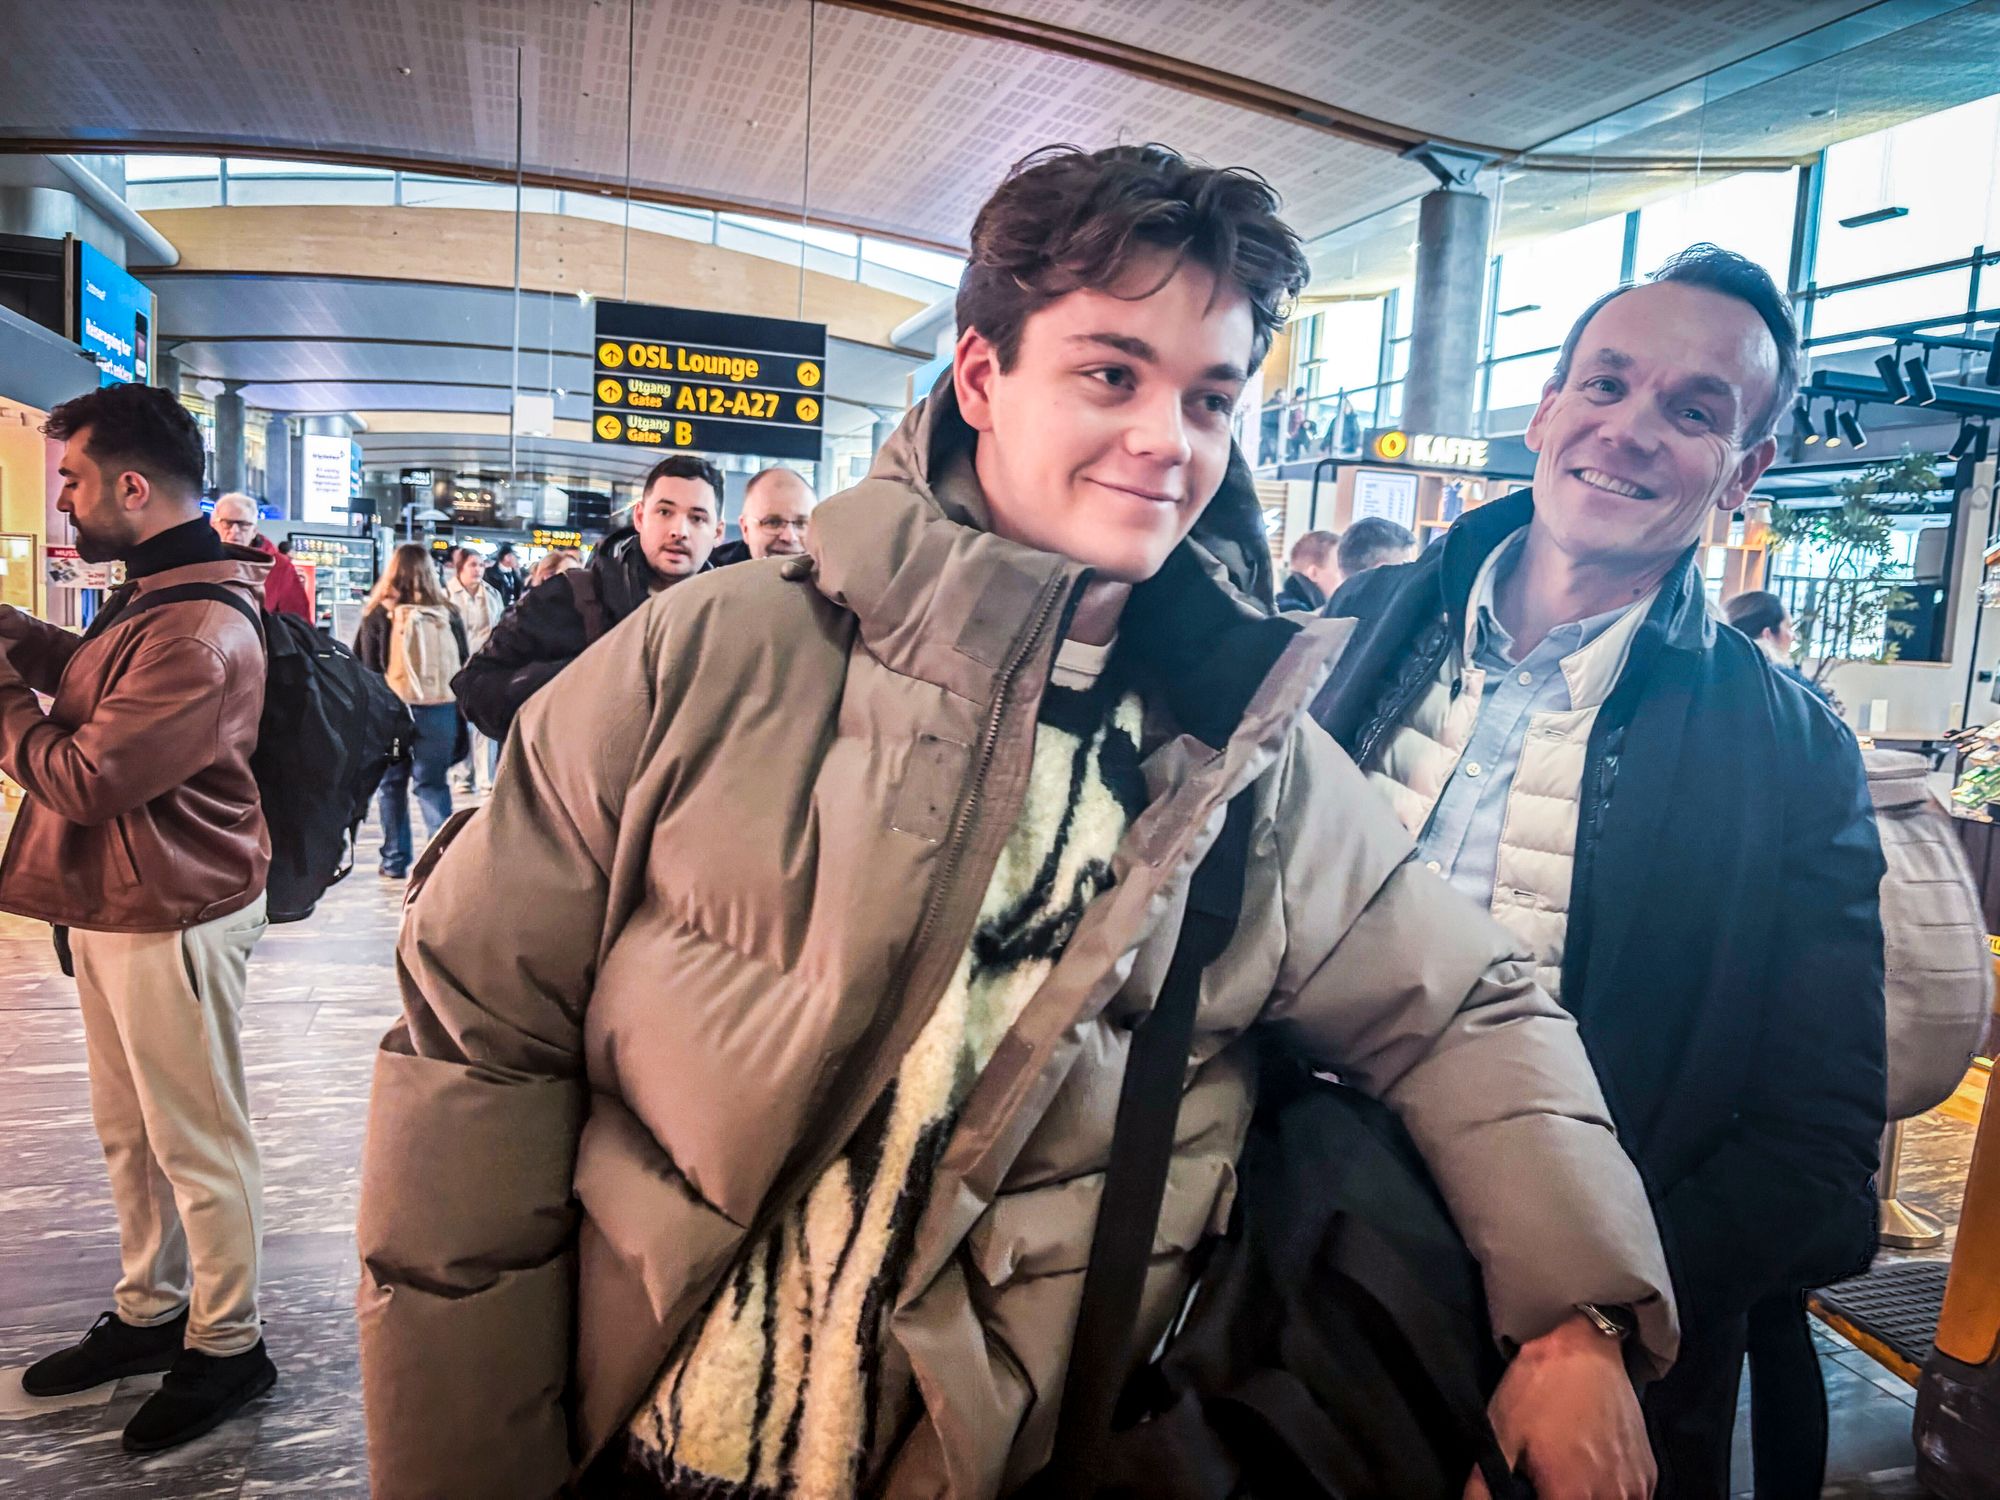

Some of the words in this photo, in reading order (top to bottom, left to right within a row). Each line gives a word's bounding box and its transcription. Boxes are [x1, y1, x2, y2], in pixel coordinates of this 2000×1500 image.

[628, 344, 672, 369] OSL
[678, 348, 758, 381] Lounge
[628, 379, 671, 397] Utgang
[628, 393, 662, 407] Gates
[676, 386, 779, 417] A12-A27
[627, 415, 670, 433] Utgang
[675, 421, 692, 445] B
[627, 428, 661, 443] Gates
[1413, 434, 1488, 466] KAFFE
